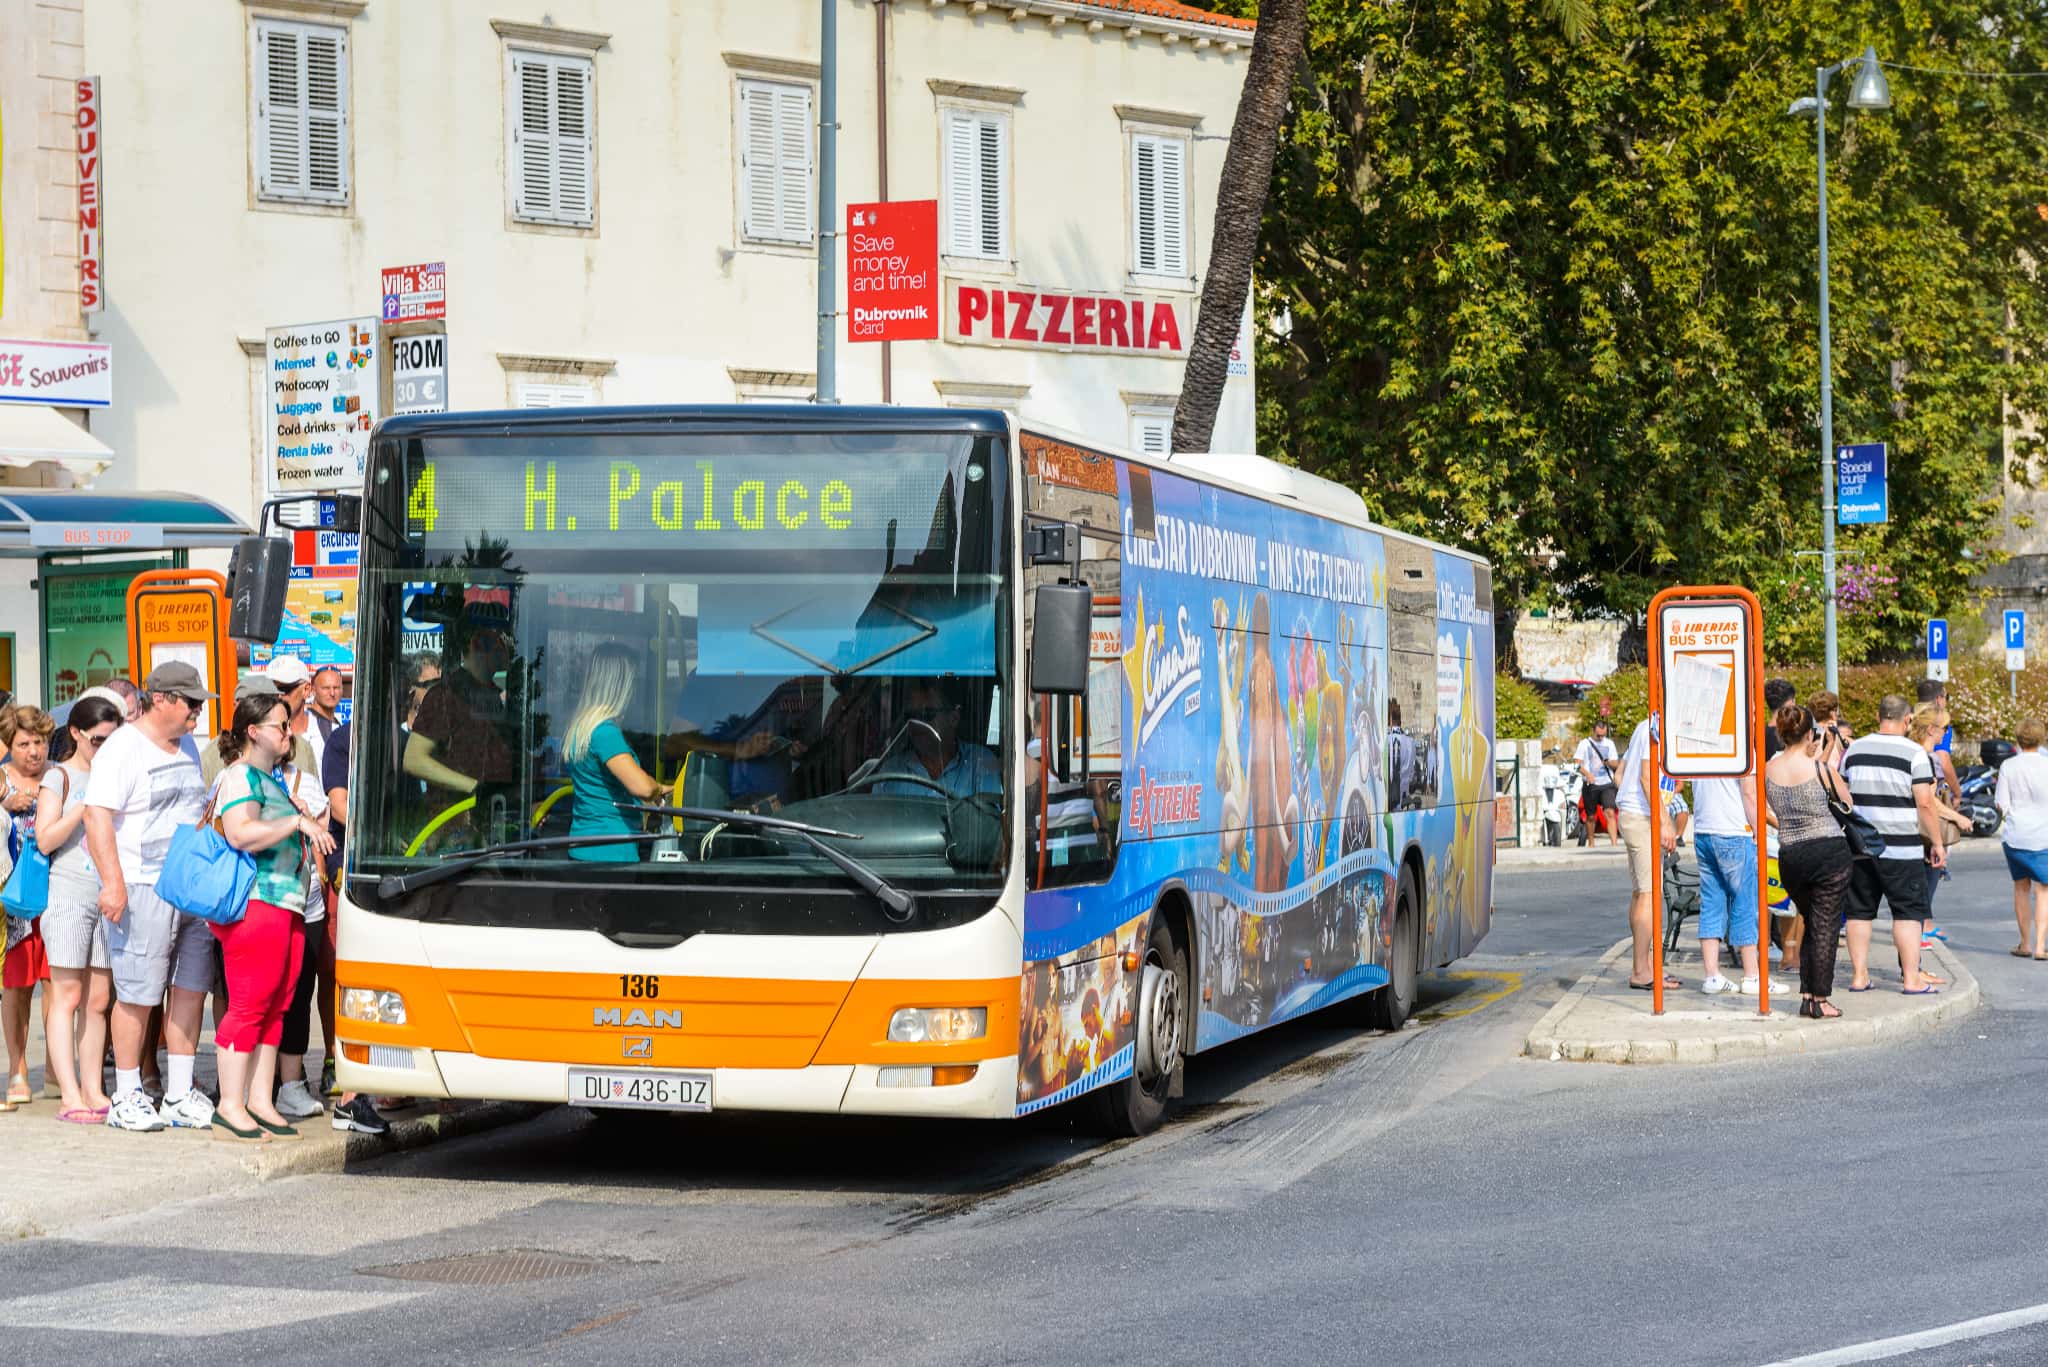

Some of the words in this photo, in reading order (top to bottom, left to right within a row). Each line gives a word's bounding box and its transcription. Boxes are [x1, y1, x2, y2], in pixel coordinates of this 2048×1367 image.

[77, 80, 99, 306] SOUVENIRS
[853, 233, 894, 253] Save
[853, 256, 909, 274] money
[383, 274, 413, 295] Villa
[418, 271, 445, 291] San
[853, 272, 885, 292] and
[889, 270, 926, 290] time!
[854, 305, 928, 321] Dubrovnik
[958, 286, 1182, 351] PIZZERIA
[853, 320, 884, 335] Card
[274, 334, 308, 349] Coffee
[311, 332, 322, 345] to
[325, 330, 340, 345] GO
[275, 356, 315, 371] Internet
[394, 339, 443, 372] FROM
[30, 353, 108, 389] Souvenirs
[275, 379, 329, 393] Photocopy
[398, 382, 416, 402] 30
[422, 380, 437, 401] €
[276, 401, 322, 416] Luggage
[277, 423, 301, 436] Cold
[304, 420, 336, 434] drinks
[311, 443, 333, 457] bike
[277, 467, 311, 481] Frozen
[314, 466, 344, 478] water
[1841, 461, 1873, 474] Special
[1841, 473, 1867, 485] tourist
[408, 462, 439, 531] 4
[524, 461, 577, 531] H.
[609, 461, 853, 531] Palace
[1842, 502, 1880, 513] Dubrovnik
[64, 529, 90, 544] BUS
[97, 528, 131, 545] STOP
[321, 532, 359, 547] excursio
[1189, 520, 1258, 585] DUBROVNIK
[1268, 540, 1294, 592] KINA
[1295, 547, 1302, 593] S
[1302, 548, 1320, 597] PET
[158, 603, 208, 615] LIBERTAS
[145, 621, 170, 633] BUS
[177, 620, 209, 633] STOP
[1685, 622, 1738, 633] LIBERTAS
[2010, 617, 2020, 642] P
[1669, 635, 1696, 646] BUS
[1704, 634, 1738, 645] STOP
[1933, 627, 1943, 653] P
[619, 974, 659, 999] 136
[593, 1007, 682, 1029] MAN
[586, 1076, 610, 1100] DU
[628, 1079, 707, 1104] 436-DZ
